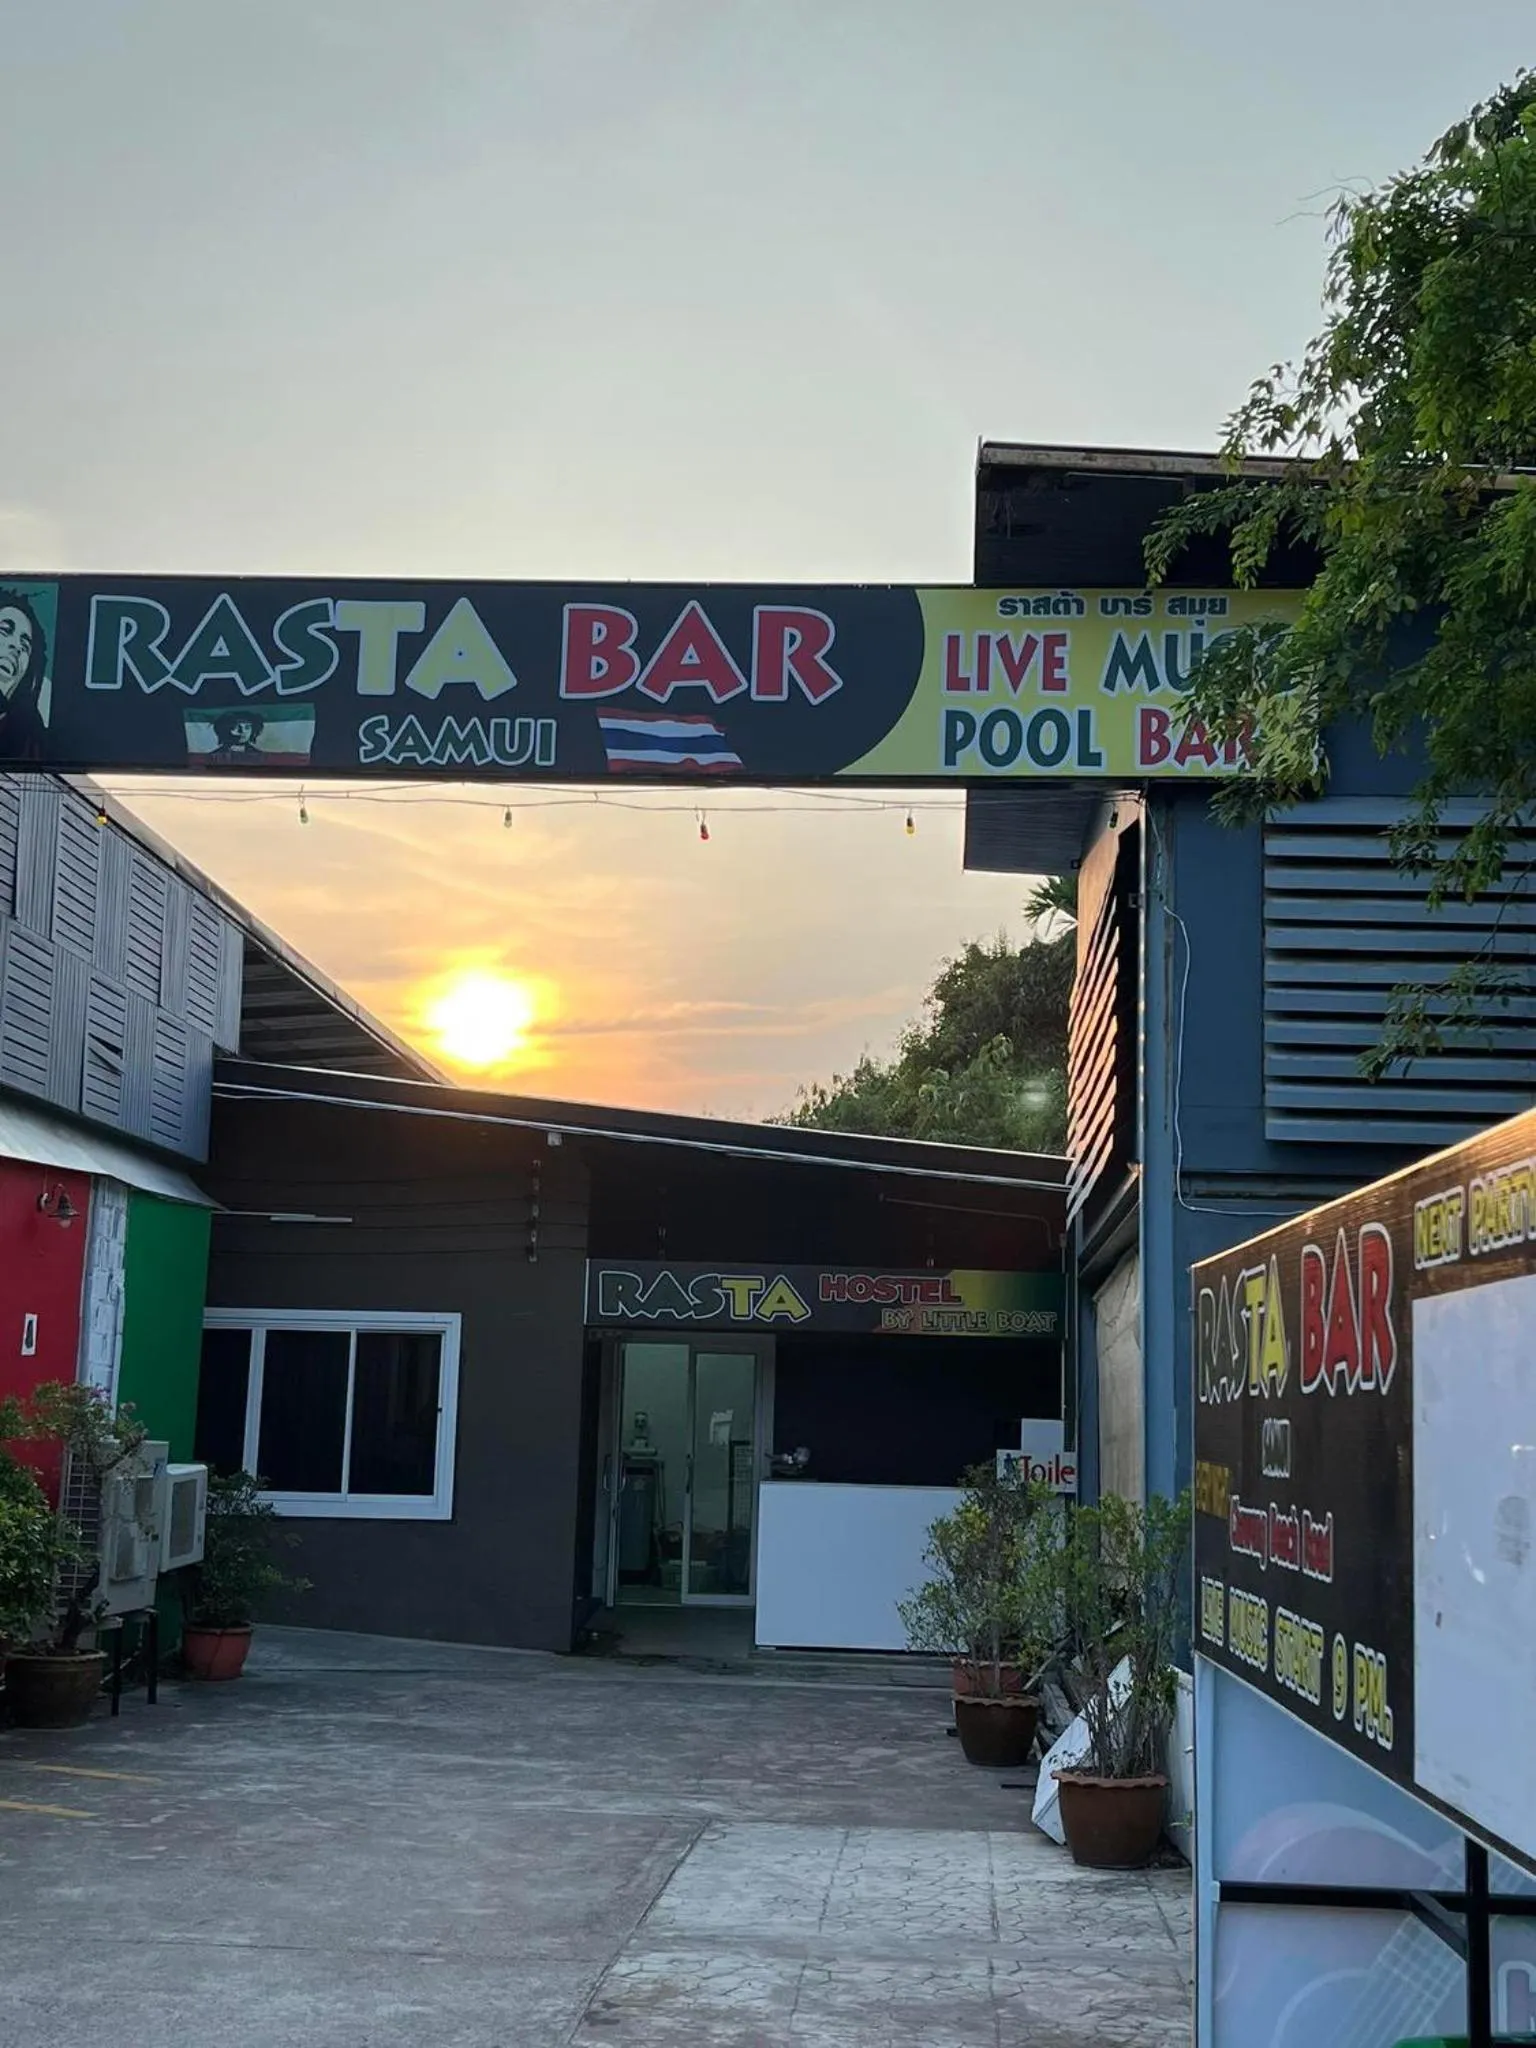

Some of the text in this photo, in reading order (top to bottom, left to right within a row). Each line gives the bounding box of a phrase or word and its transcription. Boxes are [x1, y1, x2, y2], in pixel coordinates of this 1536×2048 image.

[997, 590, 1086, 617] ราสต้า
[1099, 587, 1154, 617] บาร์
[85, 593, 843, 705] RASTA BAR
[942, 631, 1070, 694] LIVE
[359, 714, 557, 766] SAMUI
[942, 705, 1104, 769] POOL
[599, 1271, 962, 1323] RASTA HOSTEL
[882, 1308, 1058, 1333] BY LITTLE BOAT
[1198, 1222, 1397, 1404] RASTA BAR
[1332, 1632, 1349, 1722] 9
